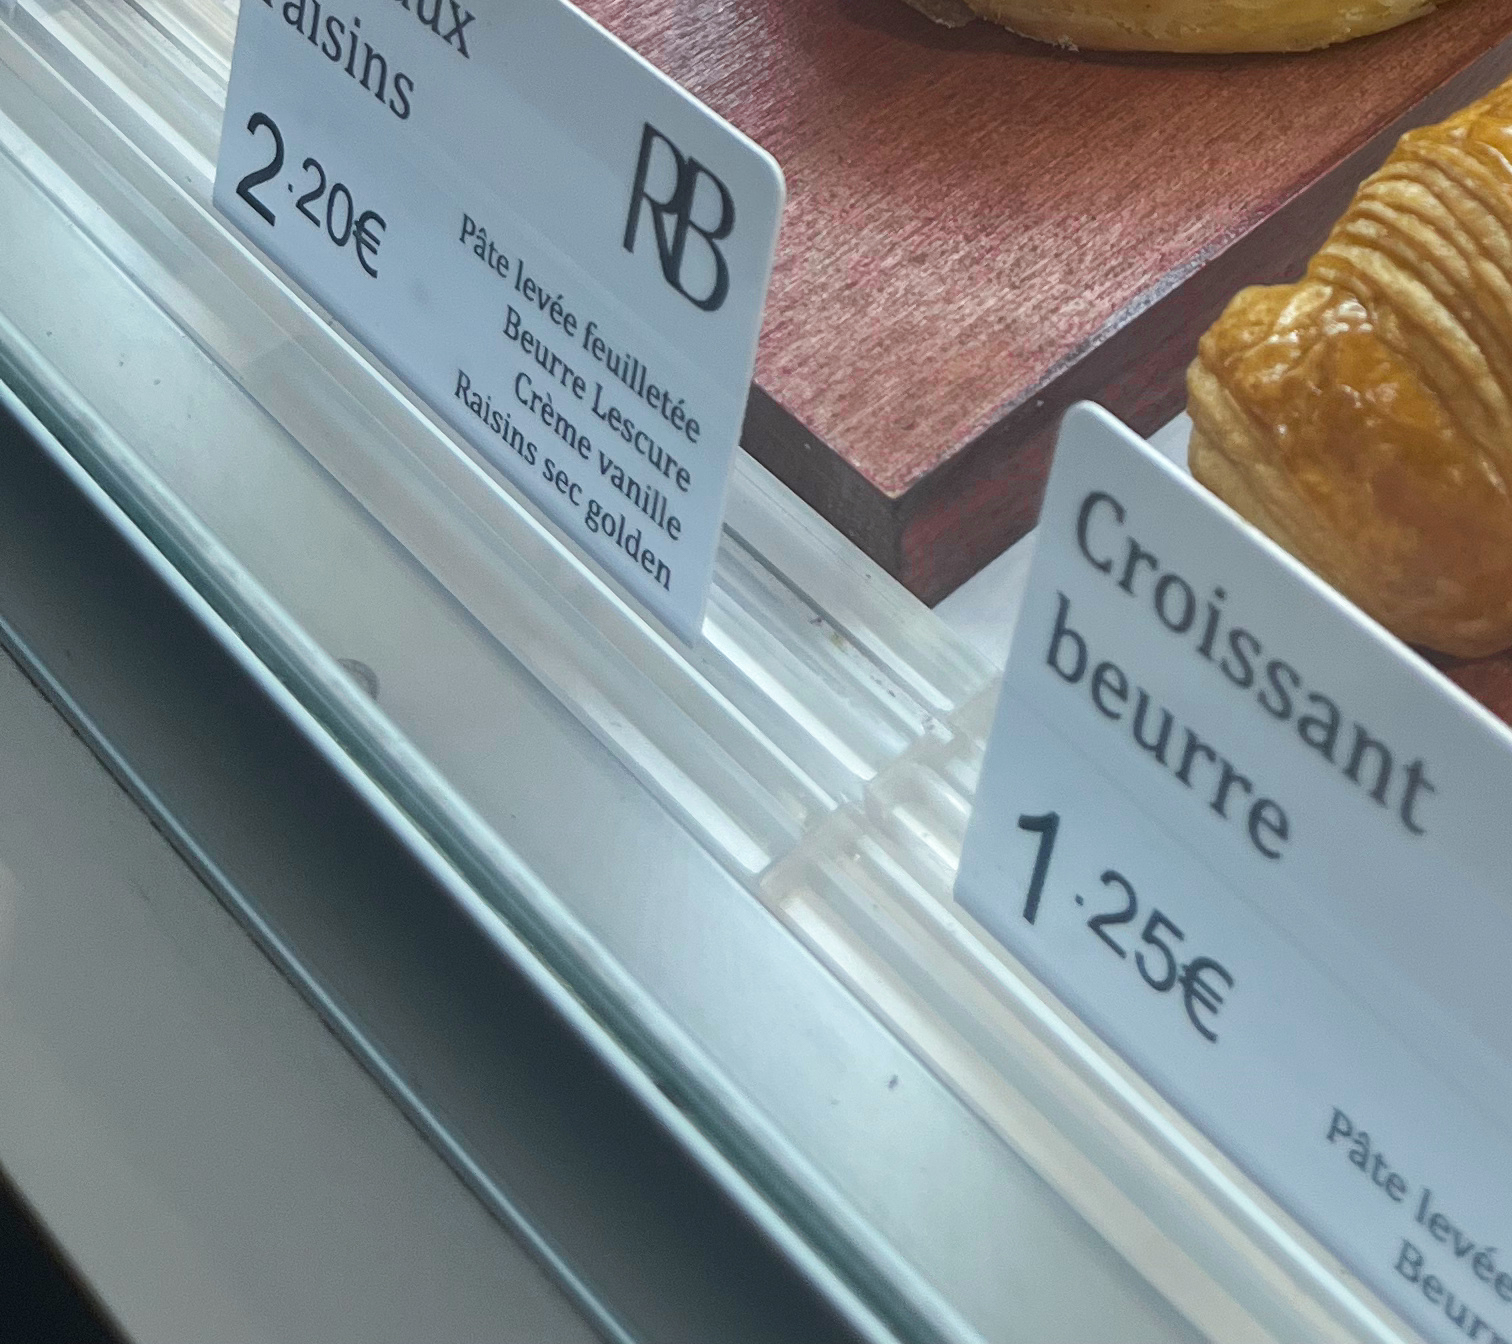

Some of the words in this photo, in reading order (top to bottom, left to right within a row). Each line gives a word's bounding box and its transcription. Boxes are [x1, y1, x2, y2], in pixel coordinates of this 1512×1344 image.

[459, 213, 509, 278] Pâte
[514, 258, 578, 337] levée
[582, 321, 701, 444] feuilletée
[622, 121, 735, 312] RB
[454, 368, 538, 466] Raisins
[542, 458, 583, 506] sec
[585, 499, 672, 592] golden
[502, 305, 586, 400] Beurre
[591, 382, 692, 493] Lescure
[514, 372, 592, 461] Crème
[598, 450, 682, 541] vanille
[1045, 589, 1291, 861] beurre
[1076, 490, 1436, 837] Croissant
